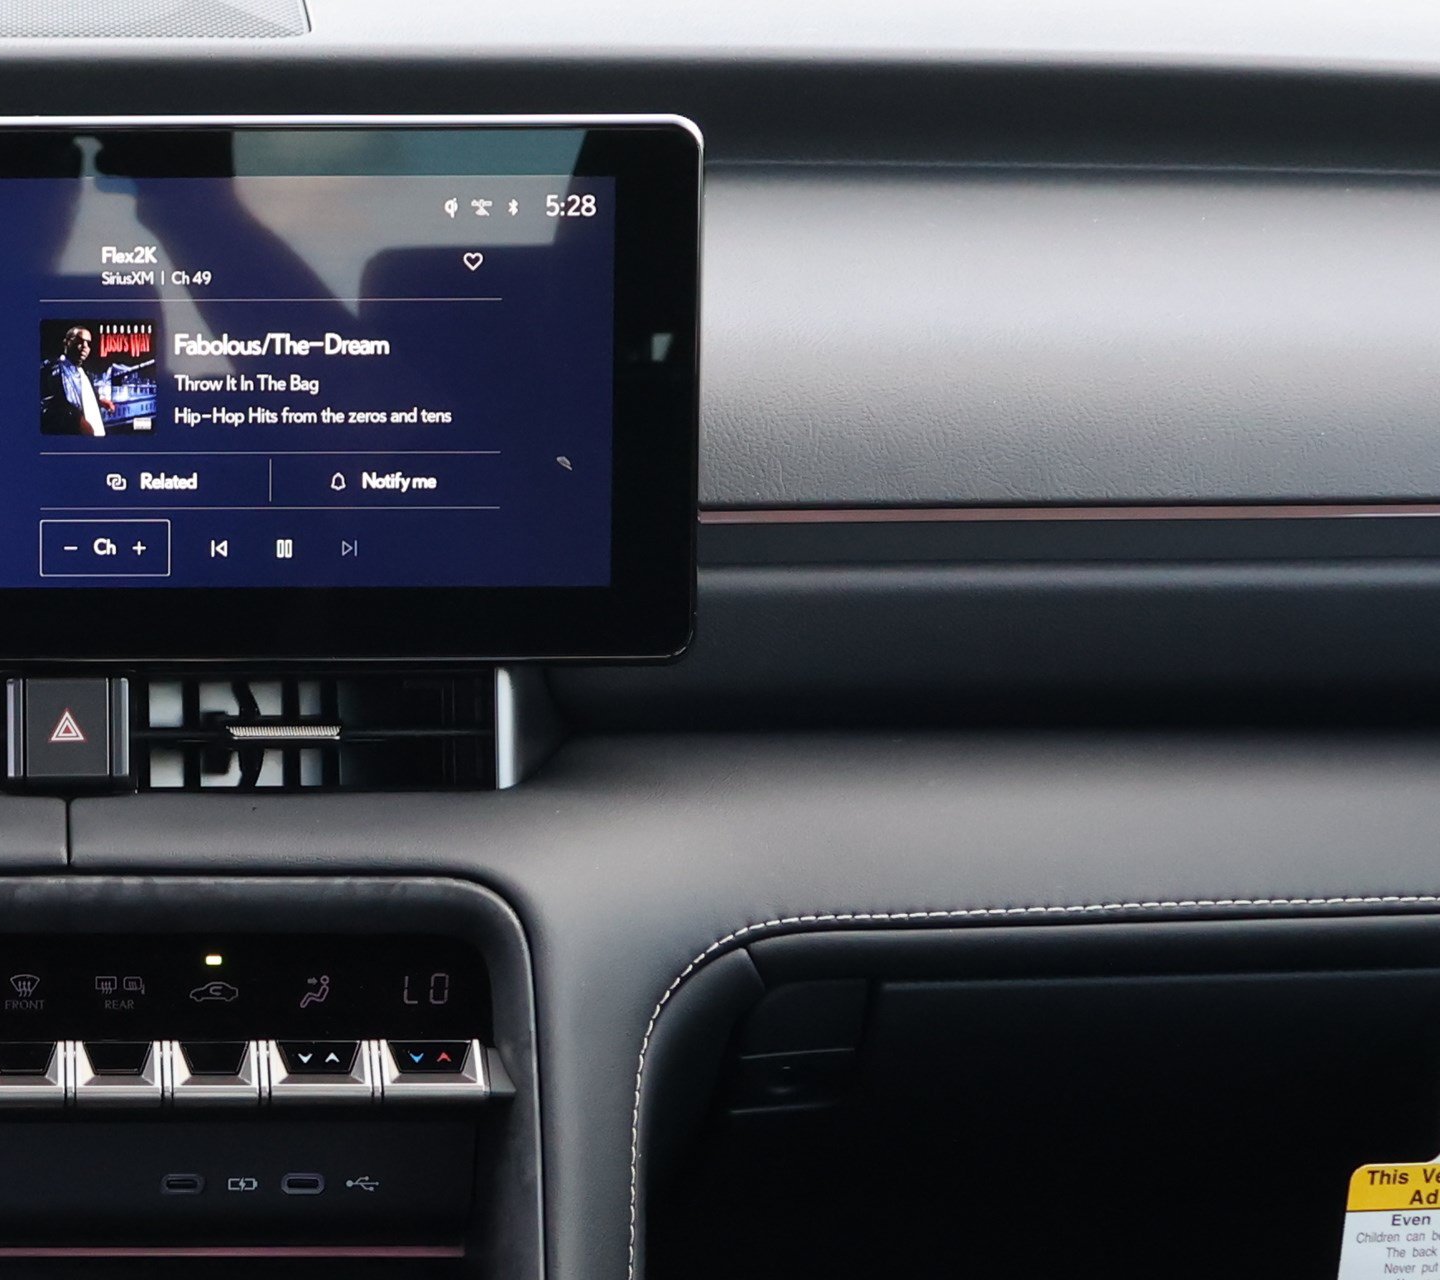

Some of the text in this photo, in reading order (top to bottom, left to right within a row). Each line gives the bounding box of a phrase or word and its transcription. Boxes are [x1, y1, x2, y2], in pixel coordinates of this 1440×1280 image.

[545, 195, 596, 217] 5:28
[101, 247, 157, 265] Flex2K
[101, 271, 212, 286] SiriusXM Ch 49
[174, 374, 320, 395] Throw It In The Bag
[174, 407, 452, 427] Hip-Hop Hits from the zeros and tens
[140, 472, 198, 491] Related
[362, 472, 437, 493] Notify me
[93, 538, 117, 557] Ch
[403, 973, 450, 1005] LO
[4, 1000, 45, 1010] FRONT
[104, 999, 135, 1010] REAR
[1368, 1169, 1409, 1185] This
[1391, 1214, 1431, 1226] Even
[1356, 1232, 1400, 1243] Children
[1406, 1232, 1425, 1241] can
[1386, 1248, 1405, 1258] The
[1413, 1247, 1437, 1257] back
[1384, 1263, 1415, 1274] Never
[1422, 1263, 1438, 1274] put
